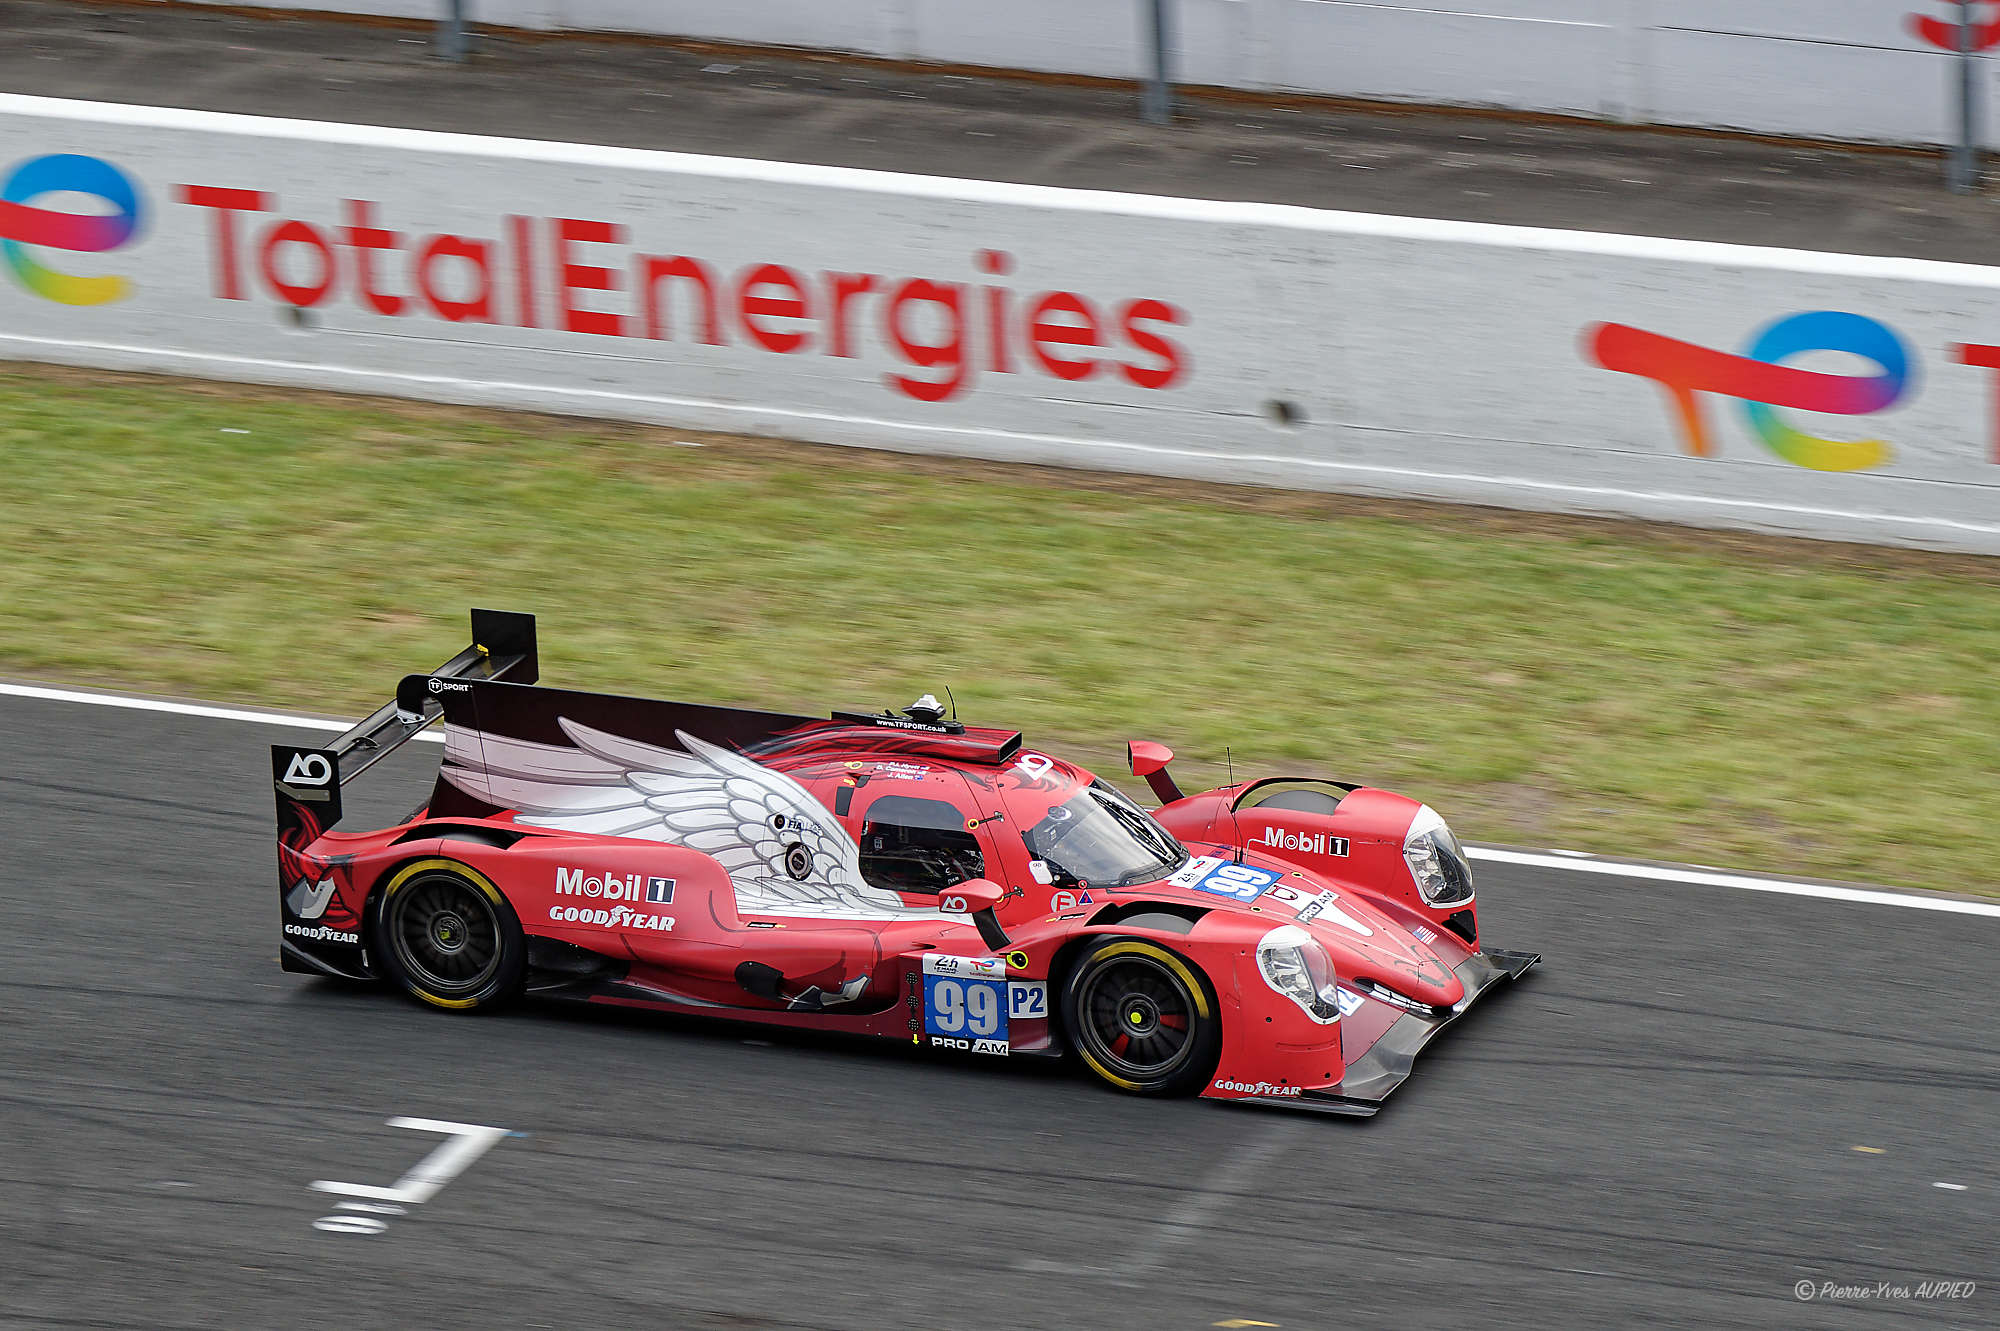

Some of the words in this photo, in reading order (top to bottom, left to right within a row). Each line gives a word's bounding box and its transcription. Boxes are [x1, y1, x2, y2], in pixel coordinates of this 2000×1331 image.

[174, 183, 1190, 402] TotalEnergies
[443, 683, 469, 691] SPORT
[876, 719, 947, 733] www.TFSPORT.co.uk
[1264, 826, 1325, 855] Mobil
[555, 866, 641, 902] Mobil
[1204, 865, 1272, 897] 99
[549, 905, 676, 932] GOODYEAR
[284, 924, 359, 943] GOODYEAR
[934, 980, 998, 1036] 99
[1012, 987, 1044, 1014] P2
[931, 1036, 969, 1050] PRO
[977, 1042, 1007, 1054] AM
[1214, 1079, 1302, 1096] GOODYEAR
